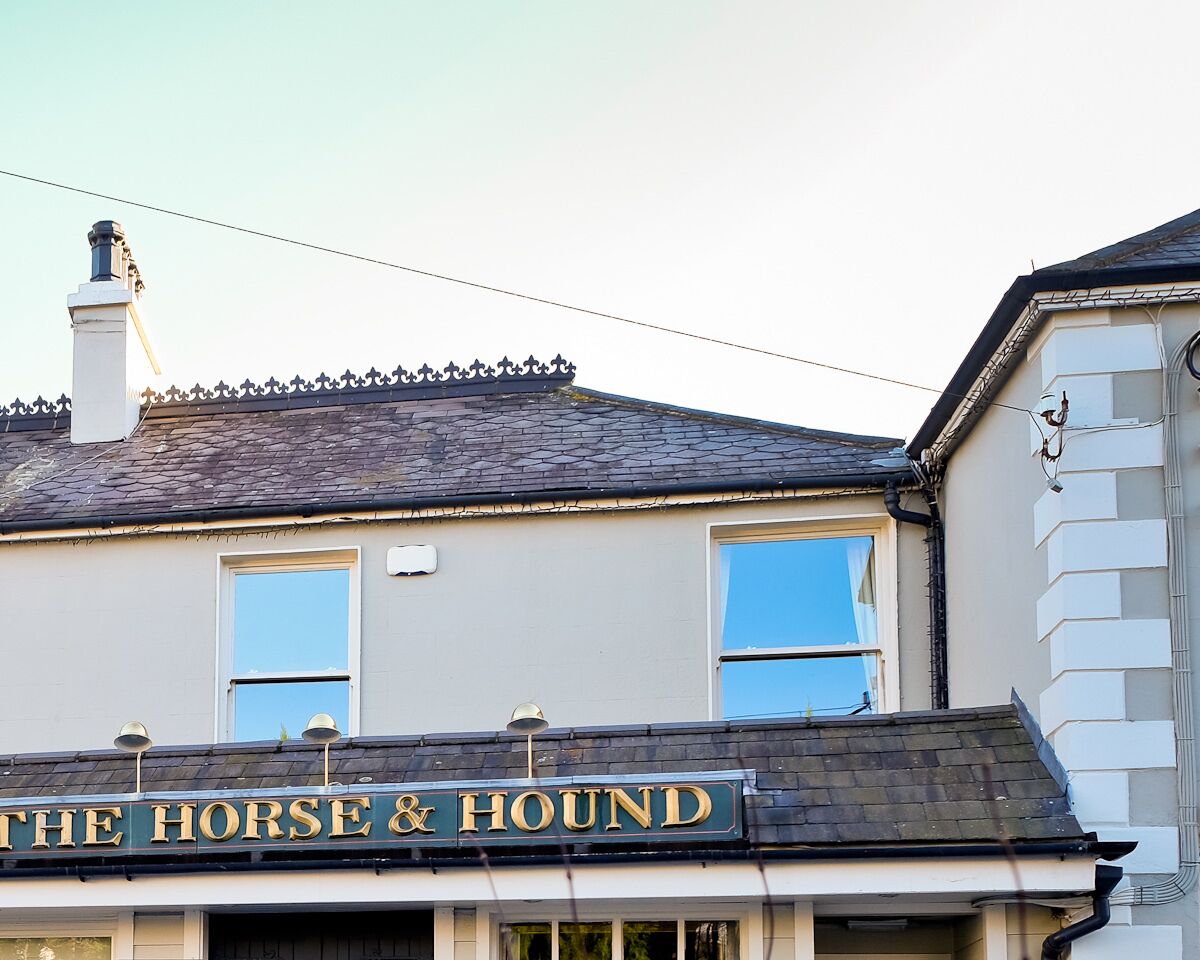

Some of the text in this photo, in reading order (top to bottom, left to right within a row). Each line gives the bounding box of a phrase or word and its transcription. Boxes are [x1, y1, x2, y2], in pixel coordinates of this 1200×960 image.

[150, 796, 373, 843] HORSE
[388, 794, 436, 836] &
[458, 785, 712, 833] HOUND
